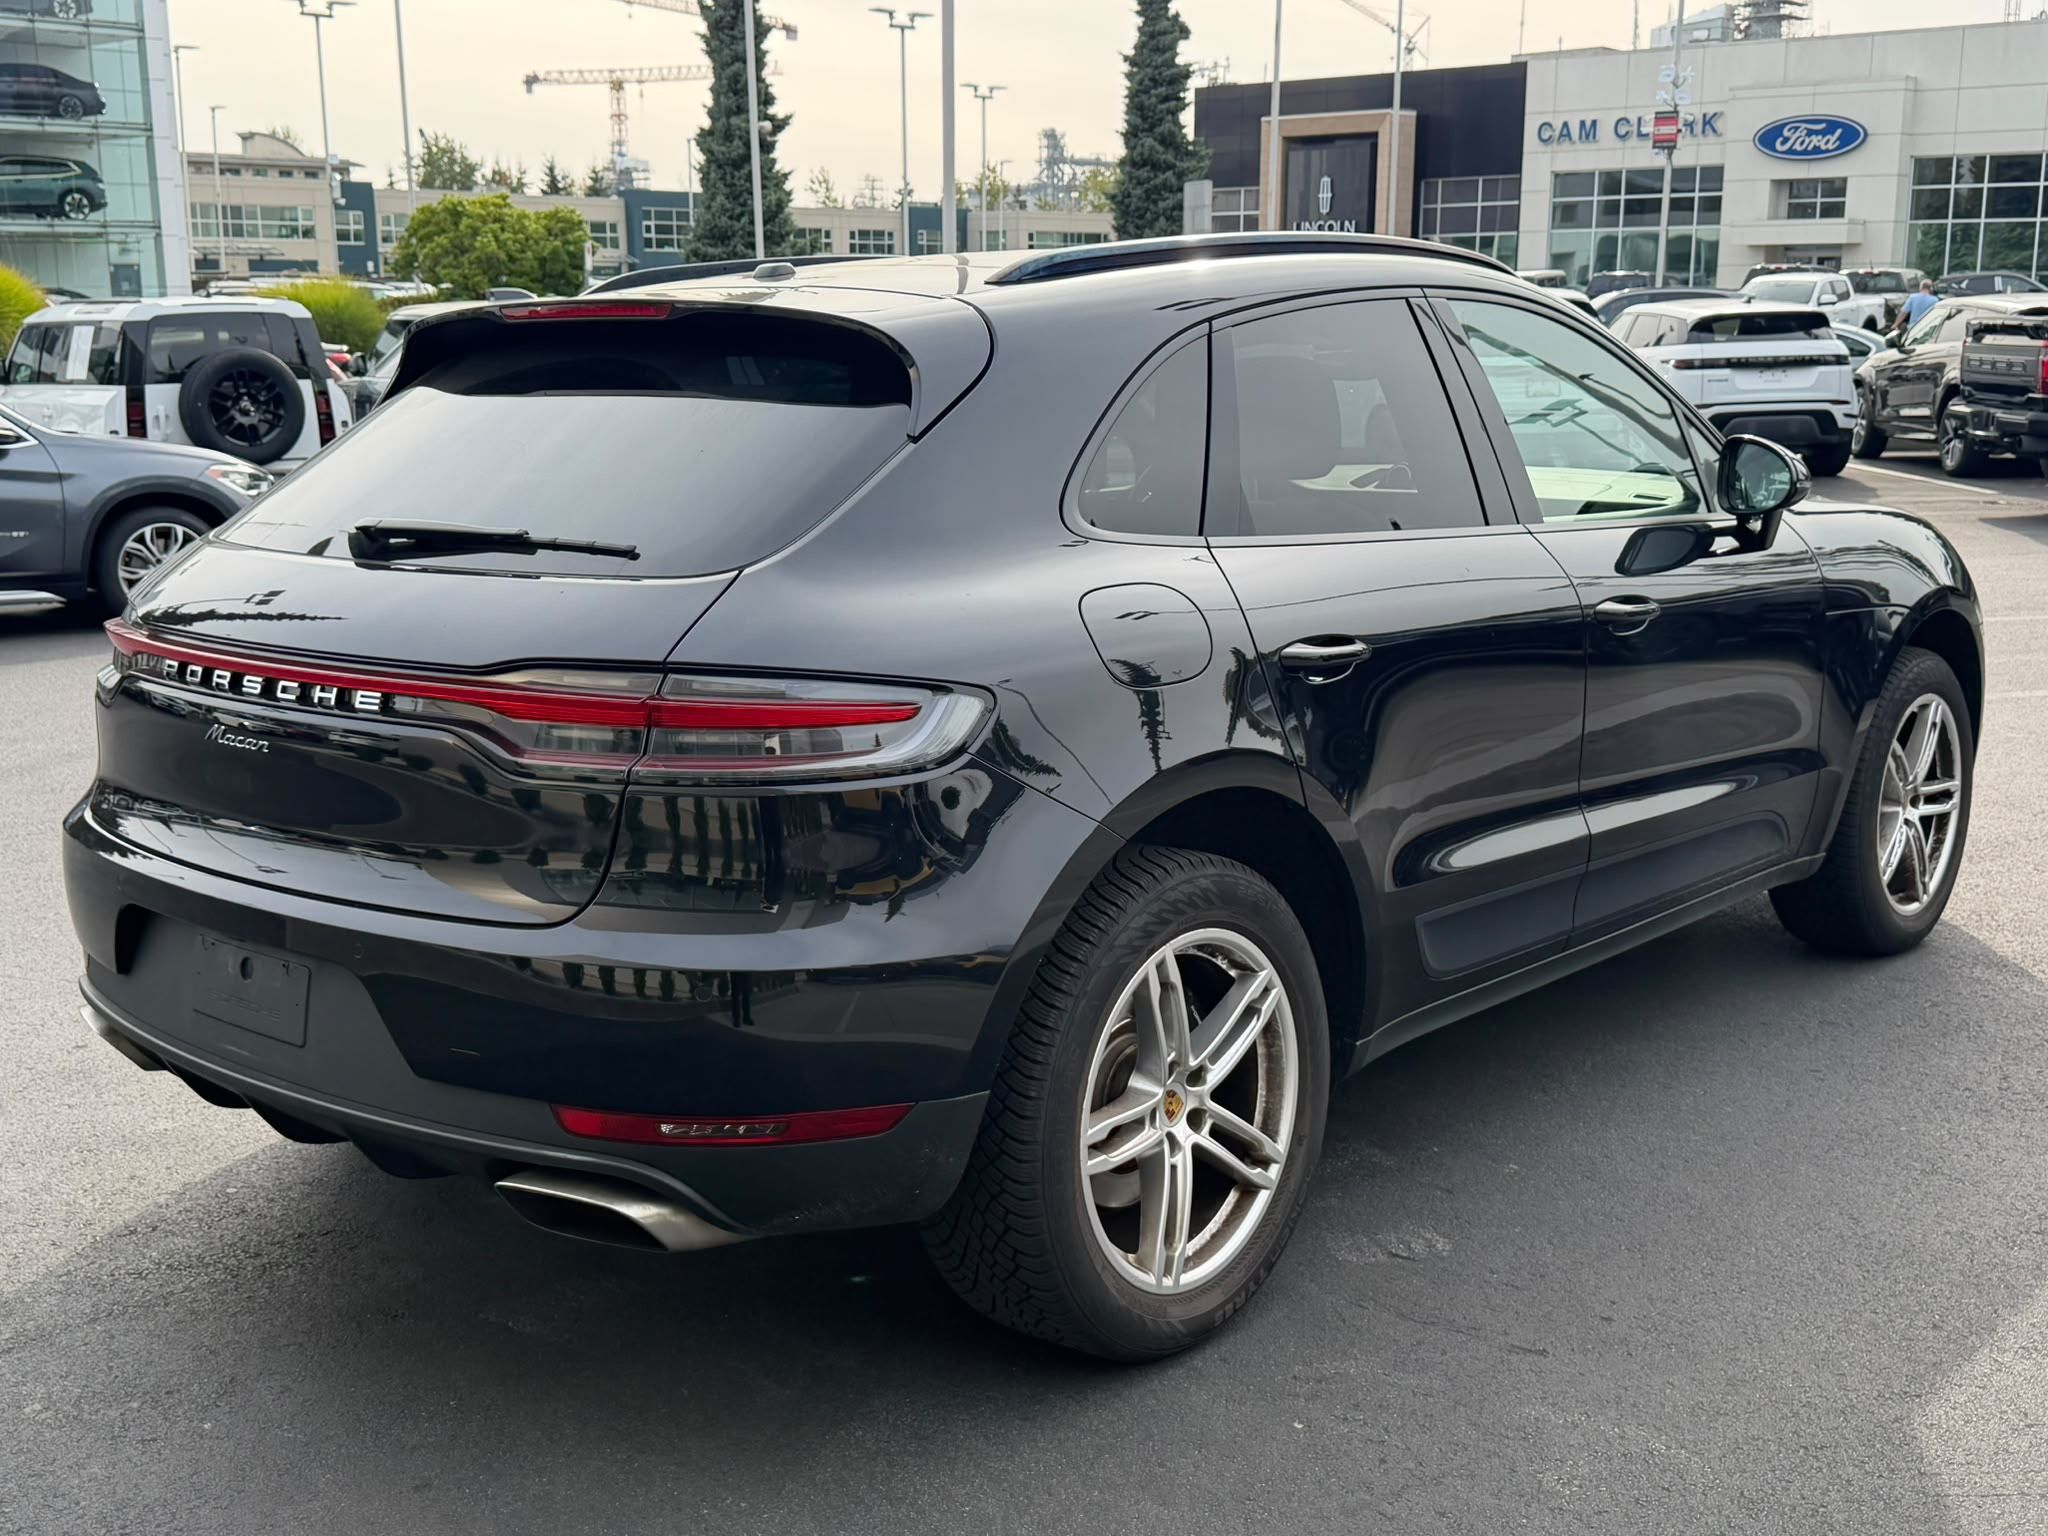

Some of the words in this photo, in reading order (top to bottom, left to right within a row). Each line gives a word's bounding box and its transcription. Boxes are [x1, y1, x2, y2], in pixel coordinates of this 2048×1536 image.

[1537, 118, 1599, 145] CAM
[1613, 111, 1724, 140] CLRK
[1775, 121, 1842, 152] Ford
[1292, 219, 1356, 233] LINCOLN
[163, 658, 383, 712] PORSCHE
[204, 723, 270, 753] Macan
